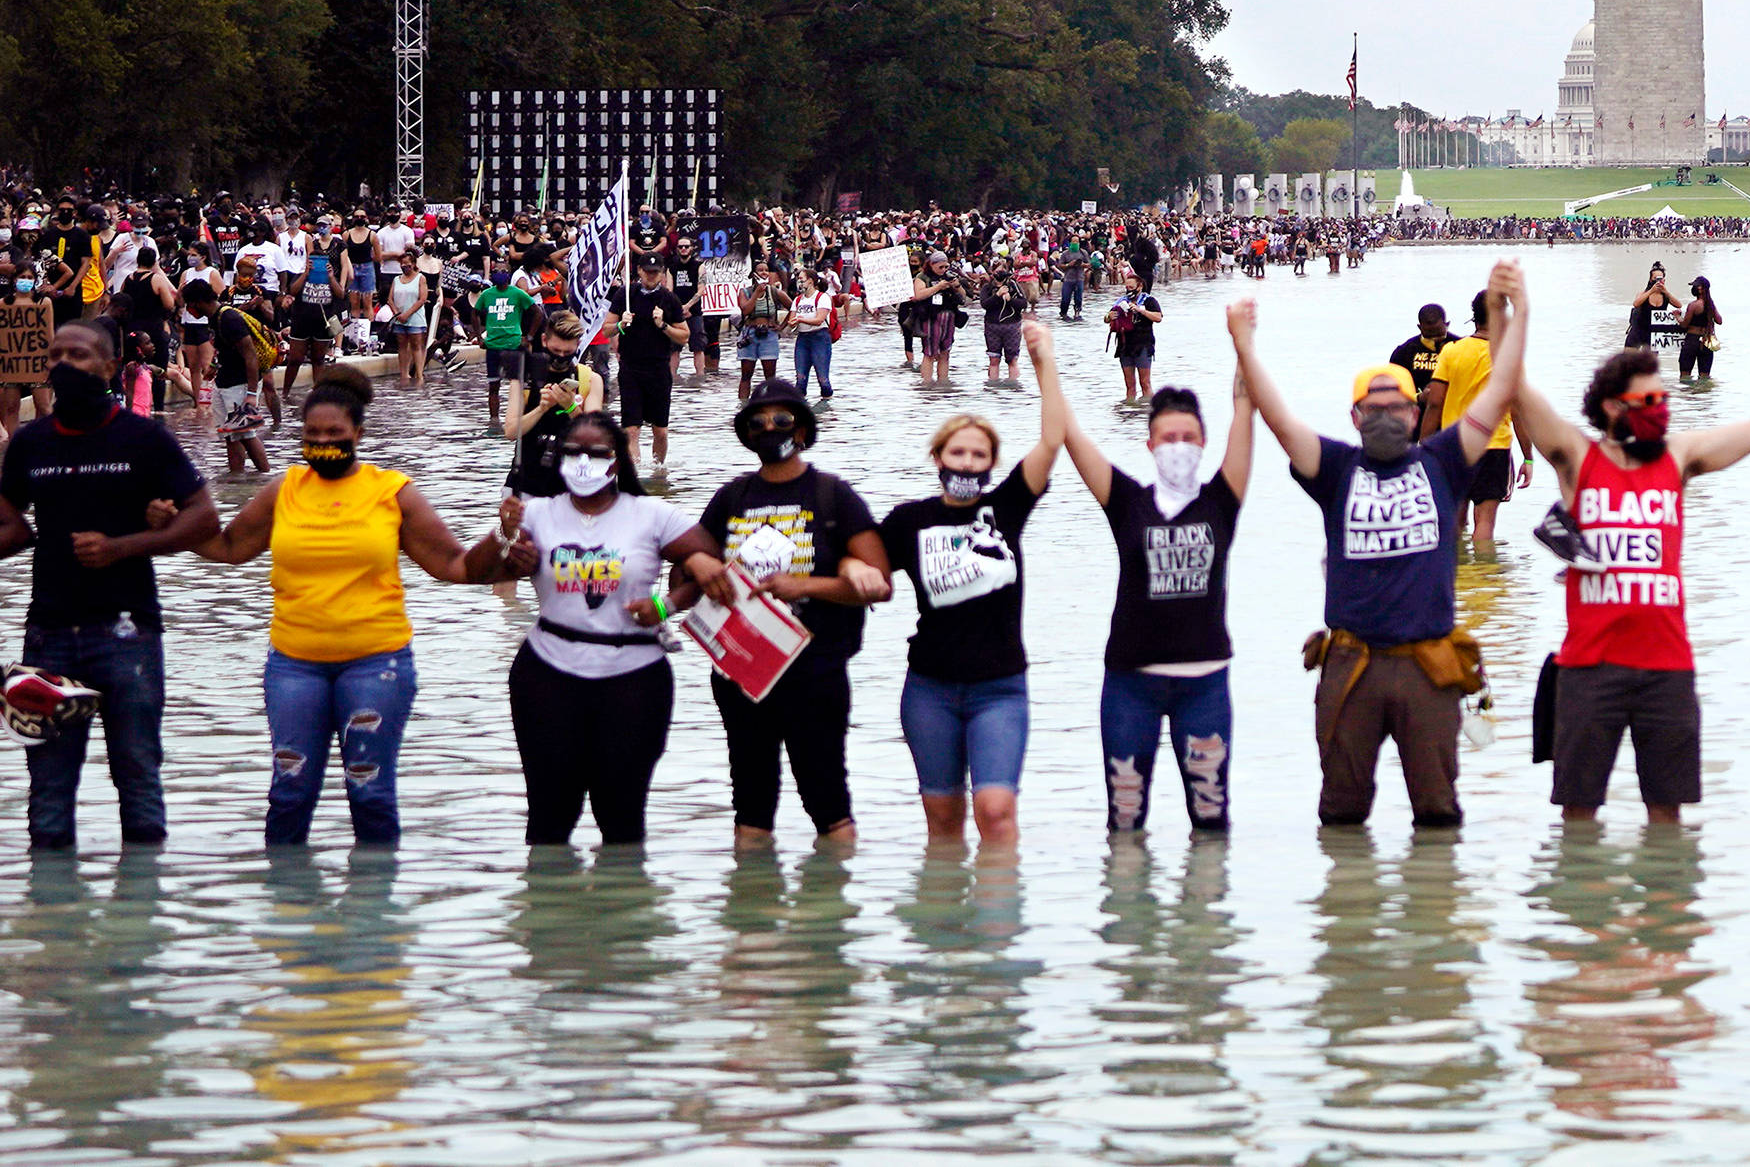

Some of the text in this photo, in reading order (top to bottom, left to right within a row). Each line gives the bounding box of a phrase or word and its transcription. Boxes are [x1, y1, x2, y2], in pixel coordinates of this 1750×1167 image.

[682, 220, 700, 233] THE
[303, 288, 331, 297] LIVES
[702, 283, 741, 309] AVERY
[488, 305, 514, 313] BLACK
[497, 313, 506, 321] IS
[79, 462, 131, 474] HILFIGER
[1350, 494, 1432, 523] LIVES
[1579, 487, 1679, 526] BLACK
[1152, 524, 1210, 547] BLACK
[1350, 523, 1438, 553] MATTER
[555, 547, 621, 563] BLACK
[1156, 547, 1207, 571] LIVES
[1596, 533, 1659, 563] IVES
[554, 560, 622, 581] LIVES
[928, 562, 984, 596] MATTER
[555, 579, 621, 594] MATTER
[1152, 571, 1209, 593] MATTER
[1580, 572, 1680, 606] MATTER
